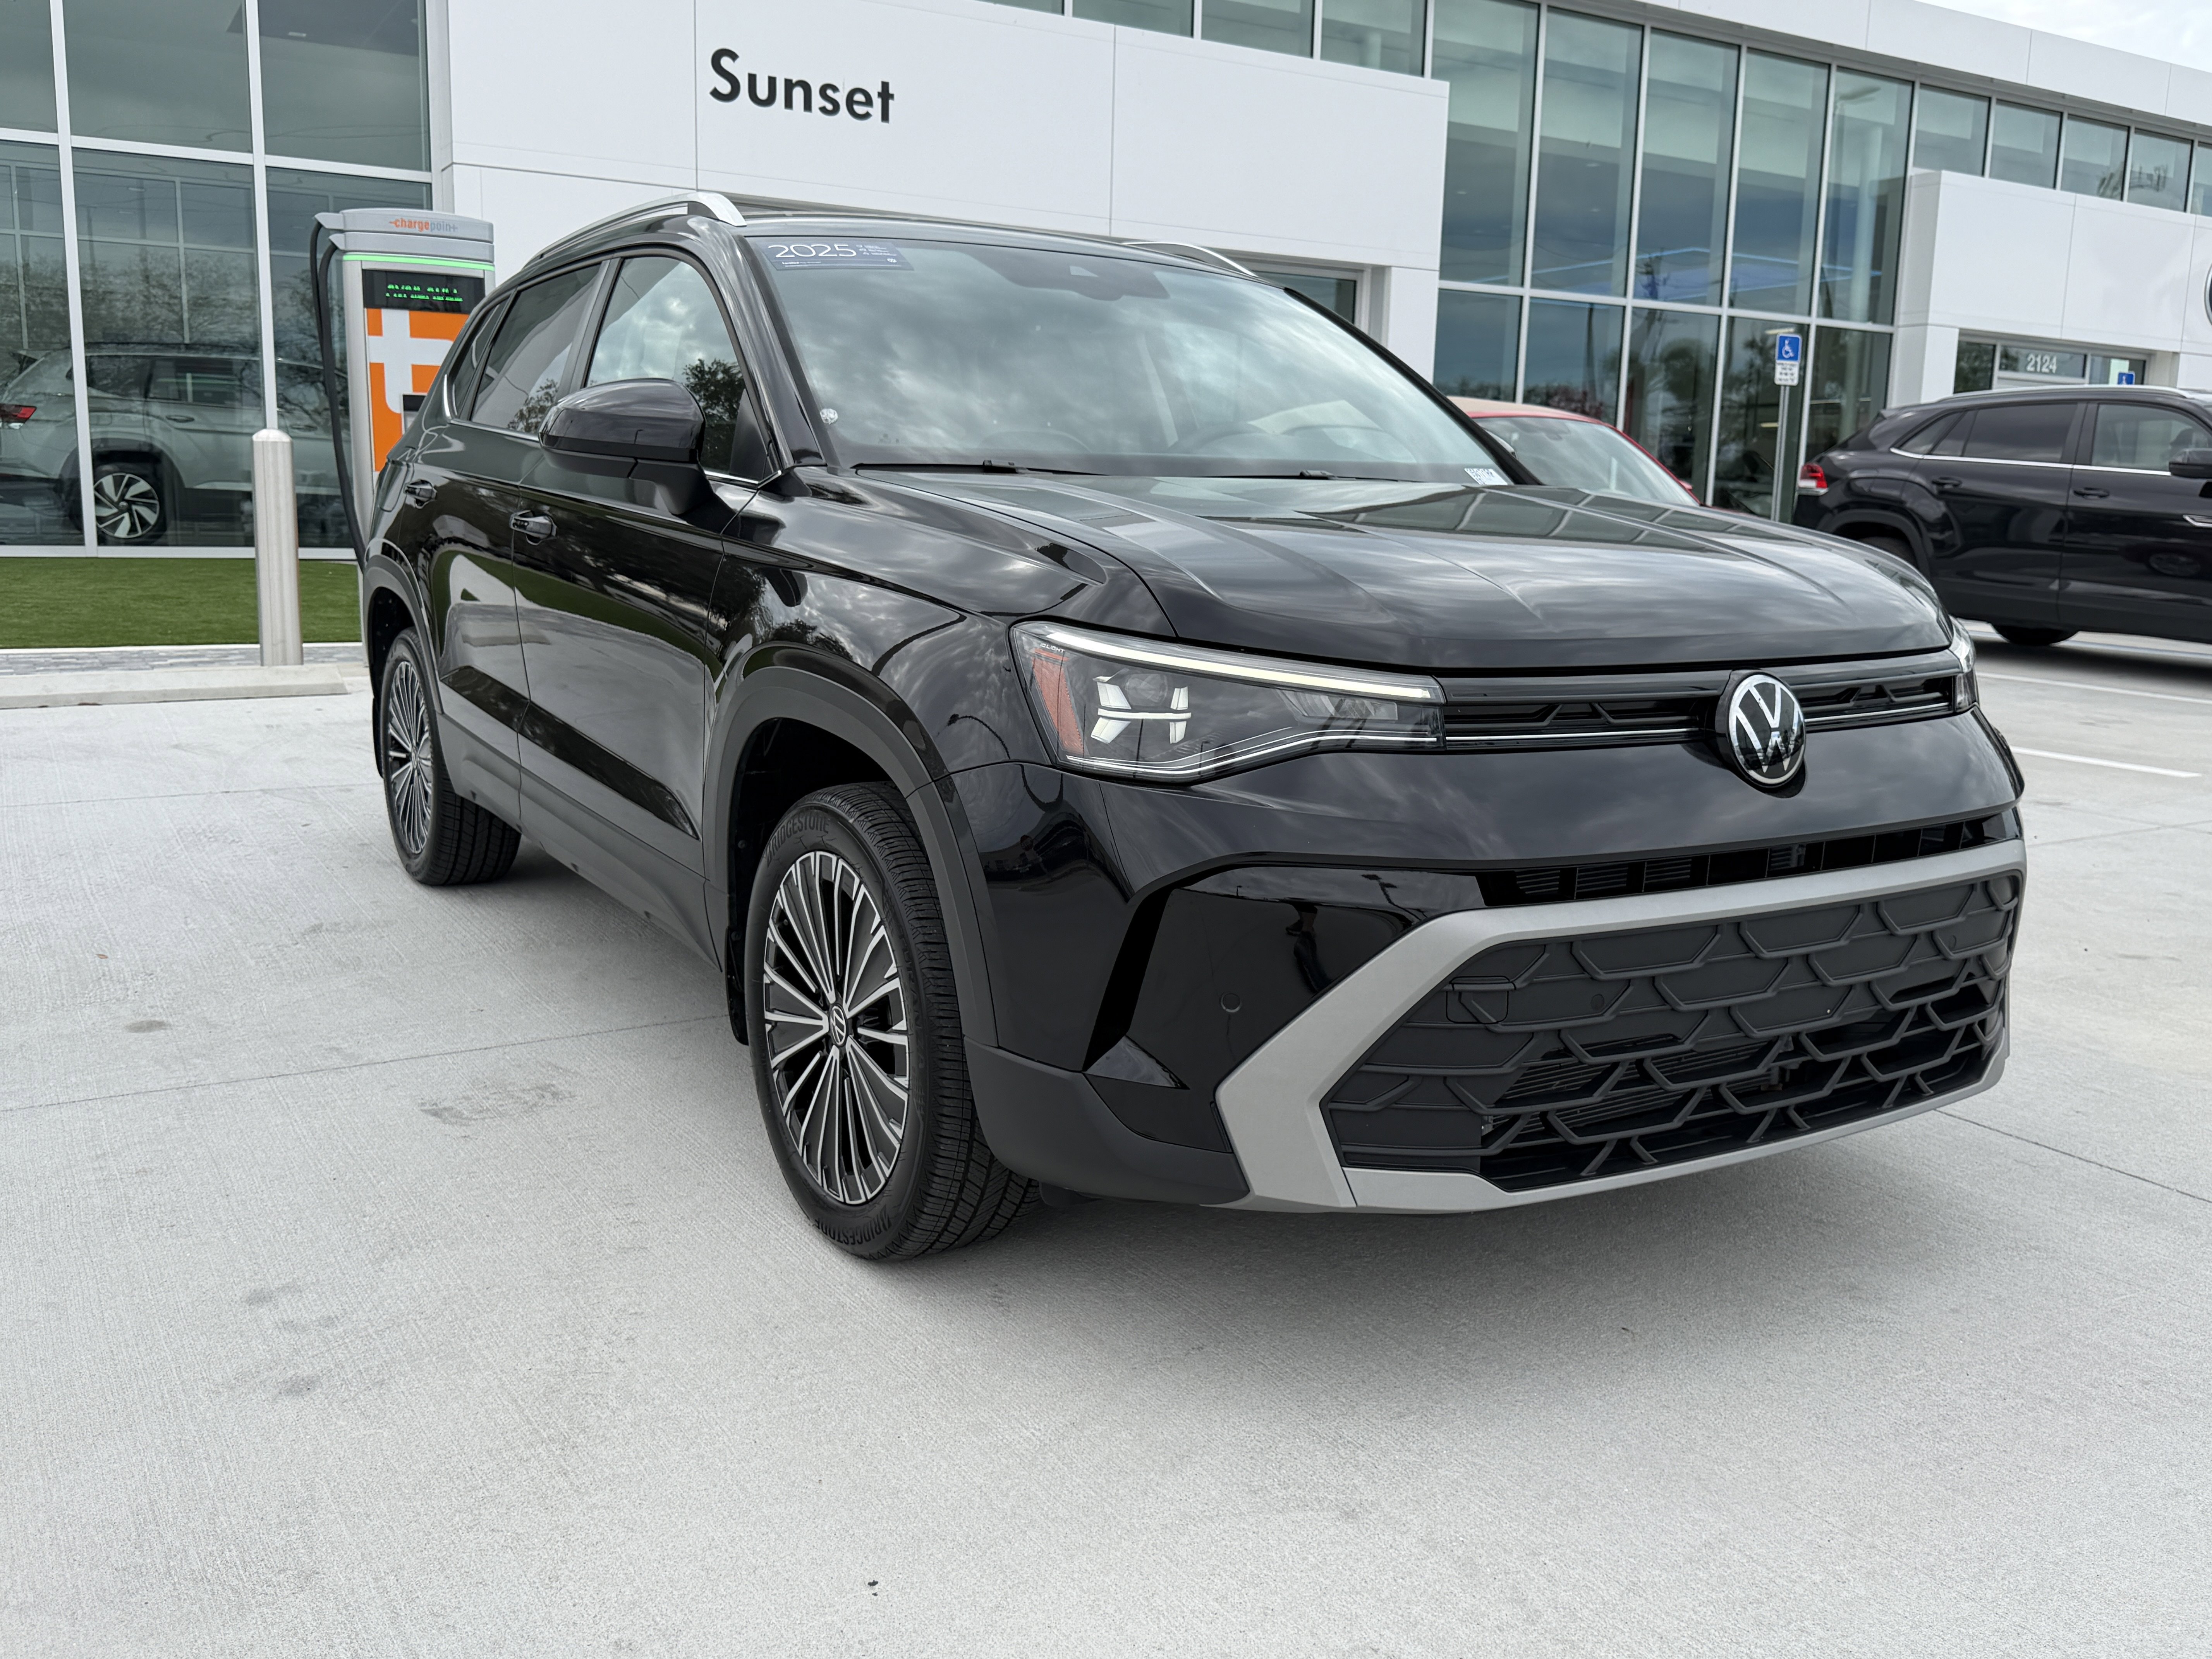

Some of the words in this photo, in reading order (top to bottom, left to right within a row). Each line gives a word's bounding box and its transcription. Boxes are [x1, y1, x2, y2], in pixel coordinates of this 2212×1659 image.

[709, 48, 894, 124] Sunset
[768, 244, 857, 258] 2025
[2026, 353, 2057, 373] 2124
